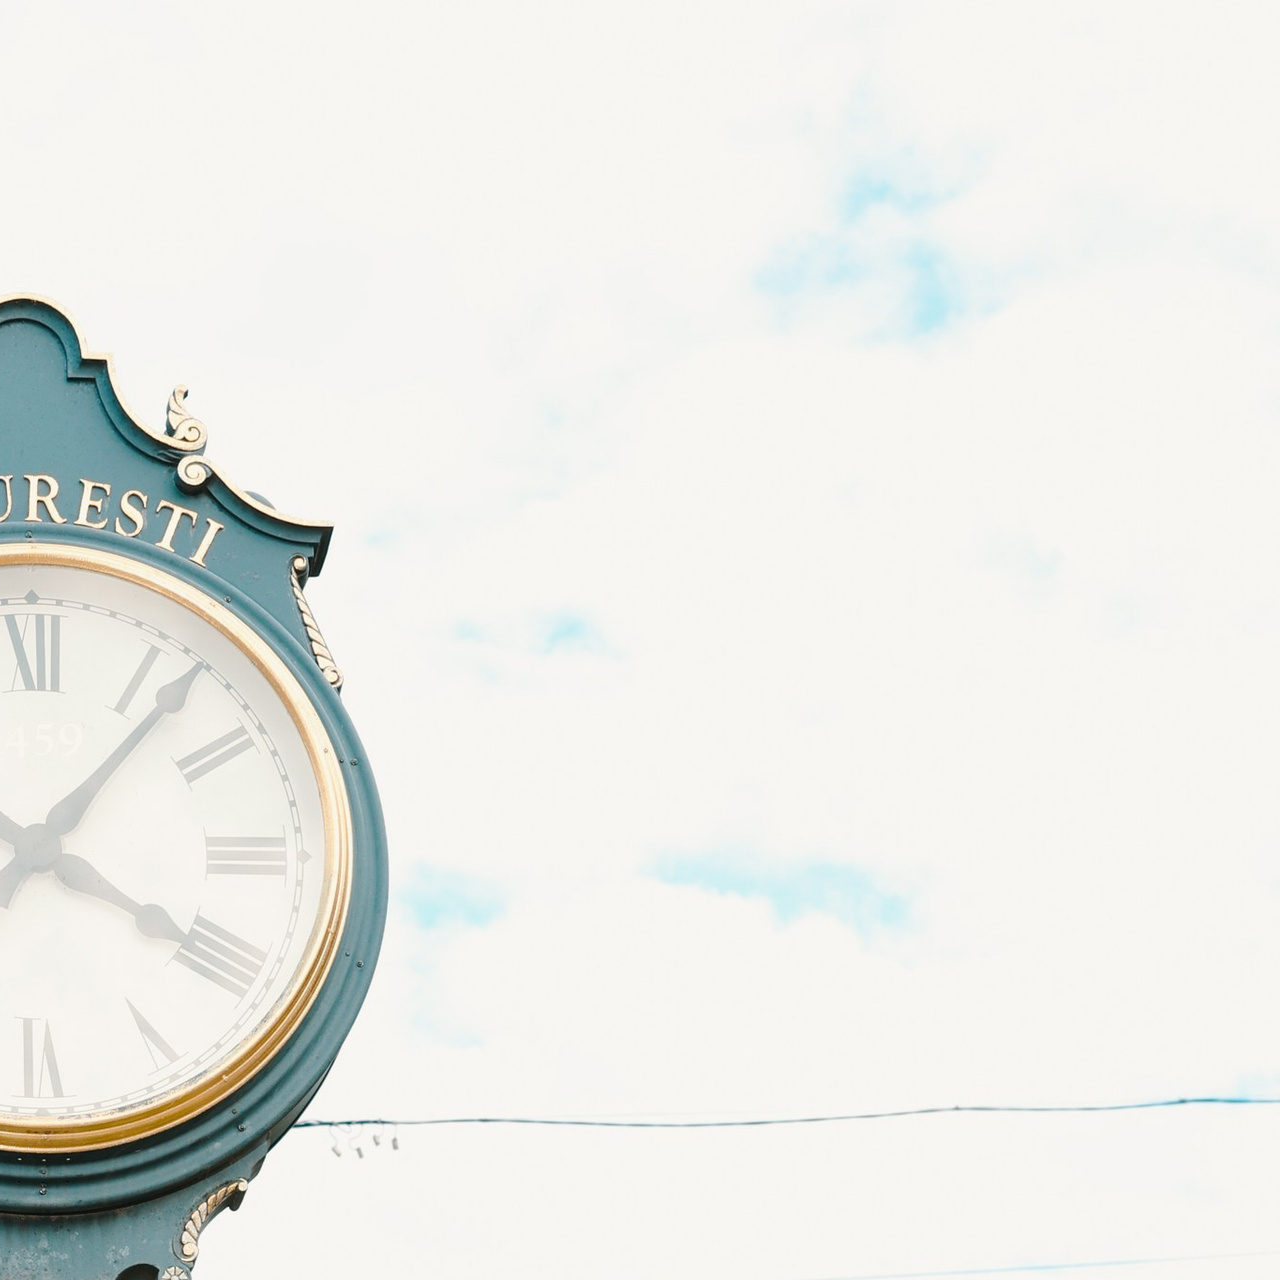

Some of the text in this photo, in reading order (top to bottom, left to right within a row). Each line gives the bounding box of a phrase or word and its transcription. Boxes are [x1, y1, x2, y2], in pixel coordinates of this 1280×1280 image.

[105, 639, 170, 720] I
[170, 717, 260, 791] II
[203, 825, 287, 887] III
[11, 1016, 77, 1098] VI
[124, 997, 189, 1076] V
